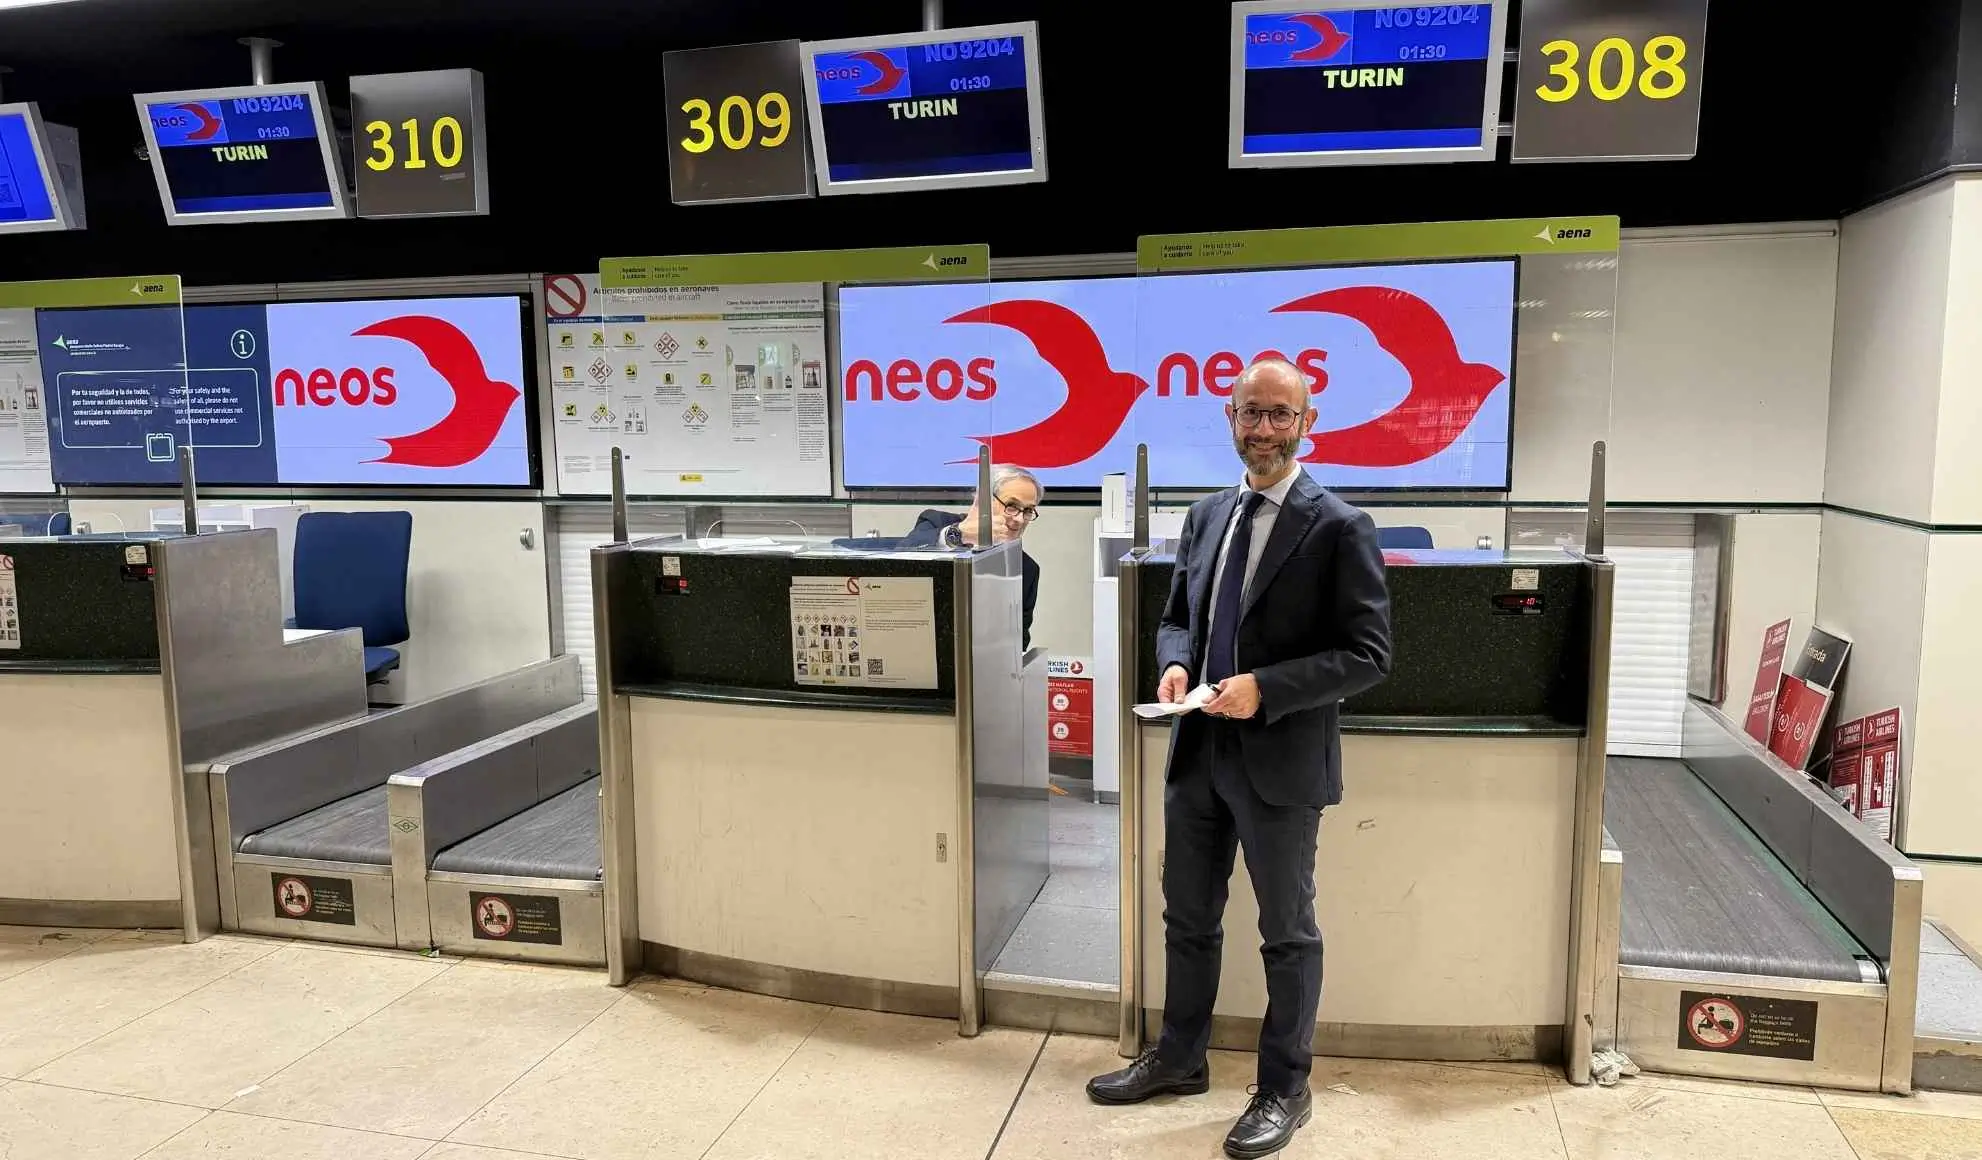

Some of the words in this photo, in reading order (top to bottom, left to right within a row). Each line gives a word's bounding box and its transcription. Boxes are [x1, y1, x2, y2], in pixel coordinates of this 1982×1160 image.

[1399, 45, 1446, 59] 01:30
[1323, 68, 1403, 88] TURIN
[1535, 36, 1686, 102] 308
[950, 75, 990, 91] 01:30
[888, 98, 958, 119] TURIN
[680, 92, 791, 153] 309
[257, 127, 290, 138] 01:30
[365, 116, 463, 171] 310
[212, 145, 268, 162] TURIN
[1557, 228, 1591, 239] aena
[940, 256, 967, 266] aena
[143, 283, 164, 293] aena
[845, 356, 997, 401] neos
[1157, 349, 1328, 396] nes
[275, 366, 397, 406] neos
[1876, 723, 1894, 737] AIRLINES
